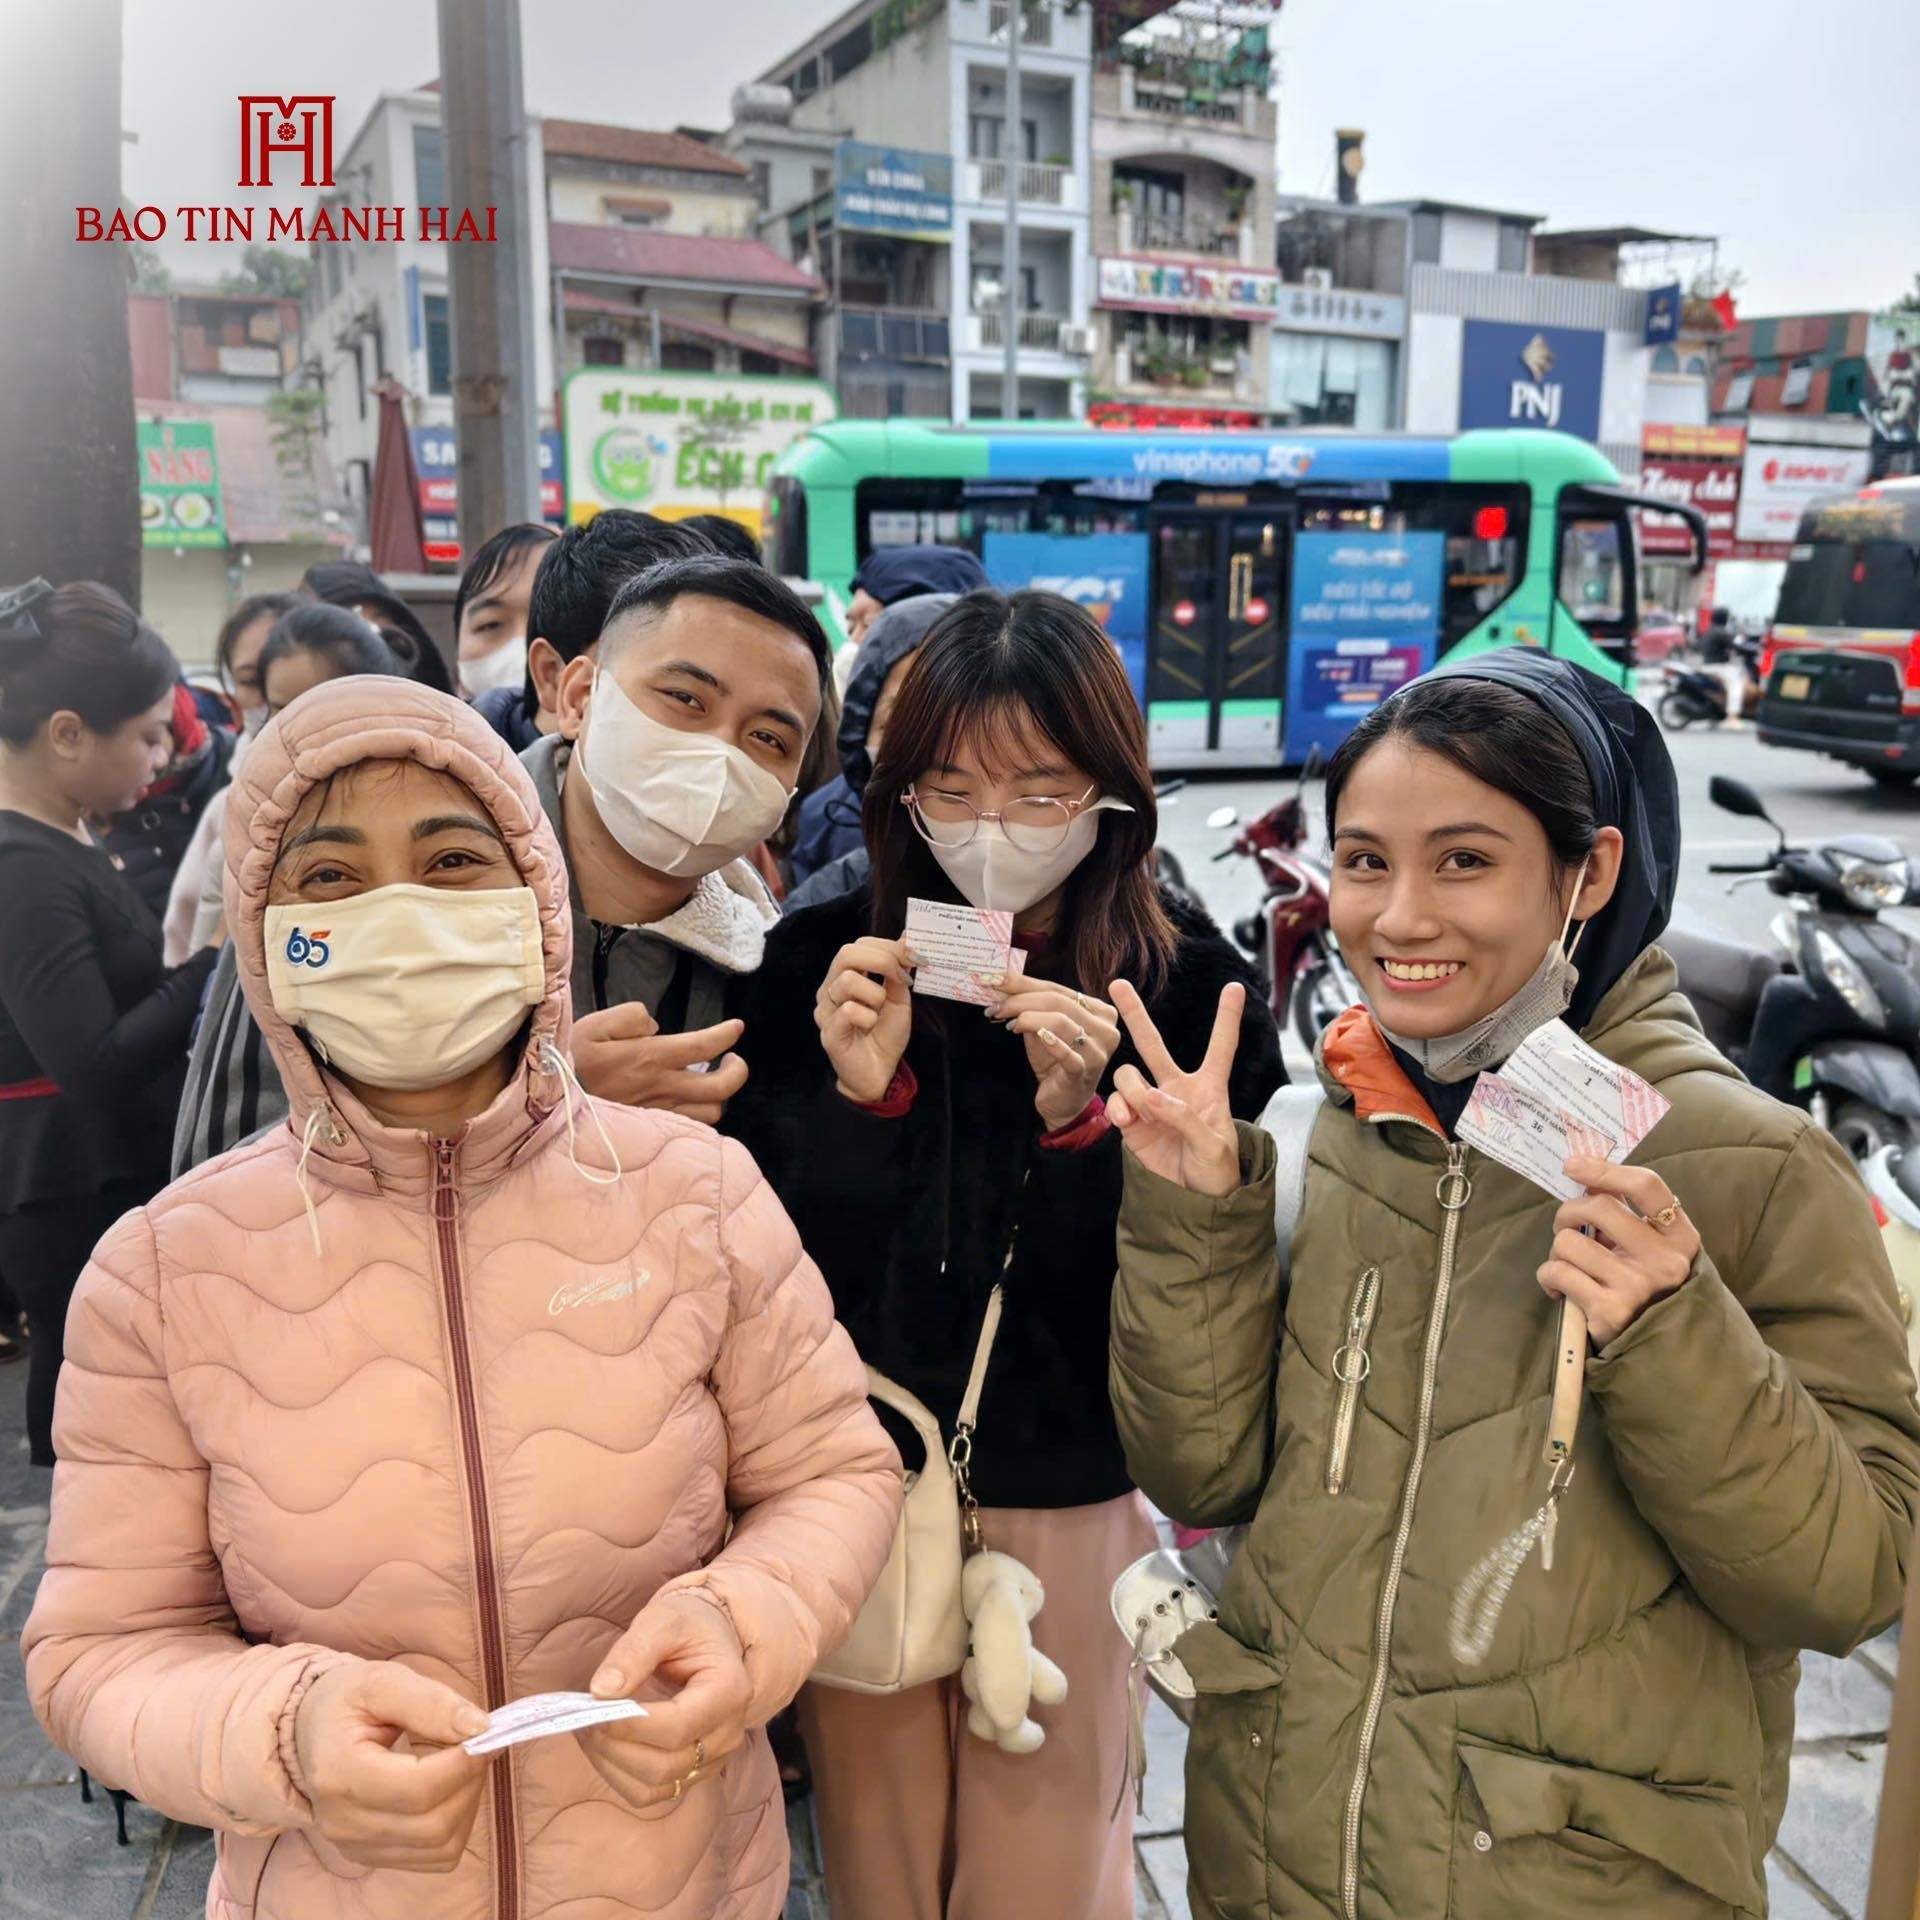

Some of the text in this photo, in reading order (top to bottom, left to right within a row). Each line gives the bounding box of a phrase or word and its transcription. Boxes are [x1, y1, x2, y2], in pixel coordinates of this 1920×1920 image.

[1509, 380, 1563, 427] PNJ
[1133, 448, 1263, 478] vinaphone
[286, 927, 332, 968] 65
[1583, 1076, 1592, 1086] 1
[1530, 1119, 1545, 1133] 36
